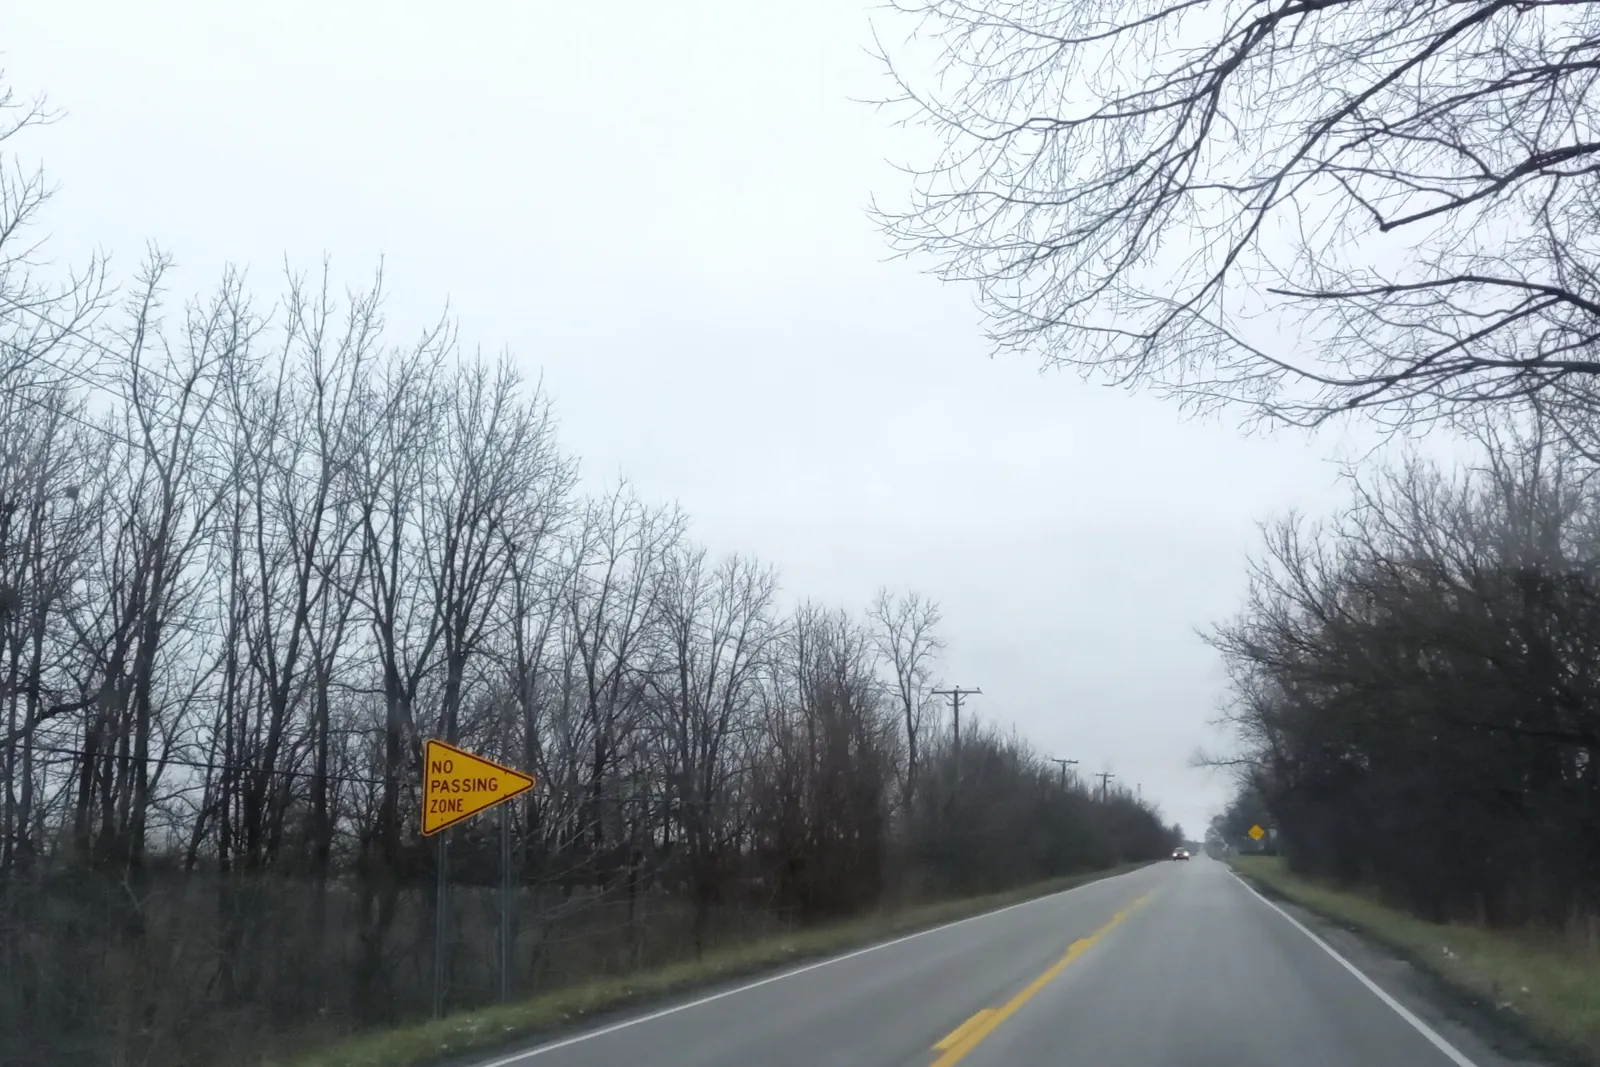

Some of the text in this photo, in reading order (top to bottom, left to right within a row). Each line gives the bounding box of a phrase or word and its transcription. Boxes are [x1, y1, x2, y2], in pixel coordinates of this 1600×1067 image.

[431, 760, 453, 774] NO
[431, 777, 498, 793] PASSING
[430, 798, 463, 813] ZONE
